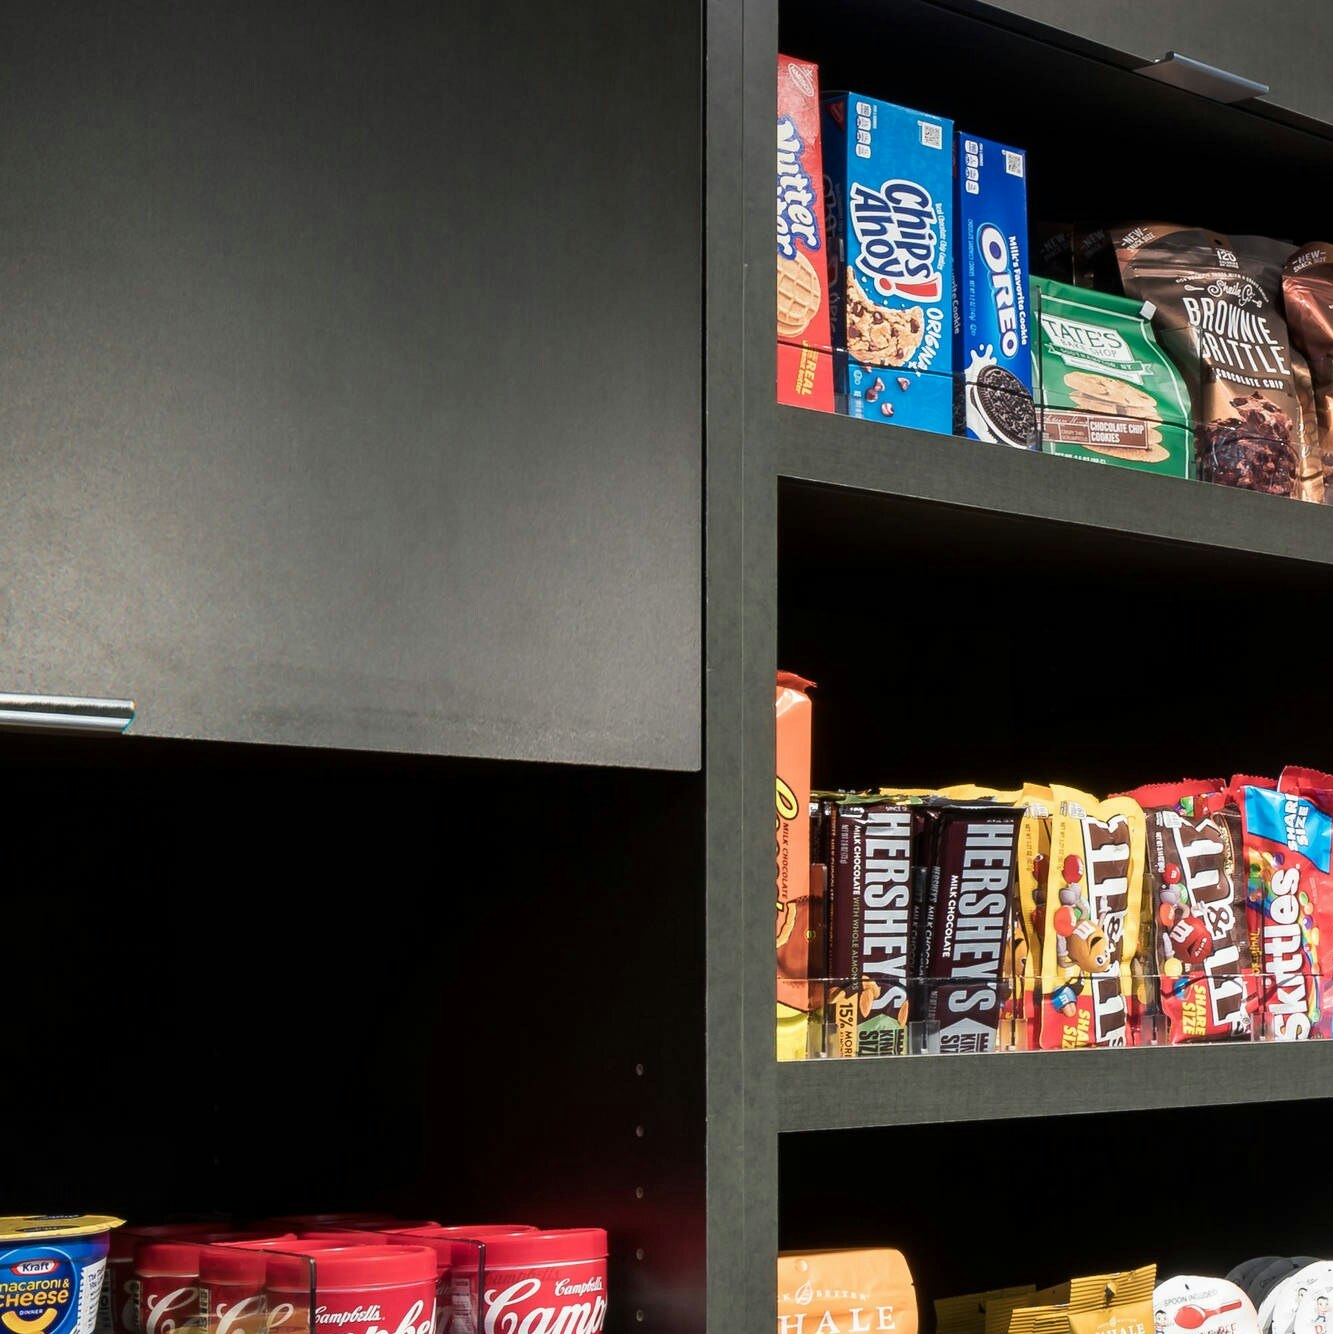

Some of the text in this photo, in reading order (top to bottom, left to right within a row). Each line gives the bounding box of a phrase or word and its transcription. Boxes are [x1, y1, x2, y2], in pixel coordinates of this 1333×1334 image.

[1217, 250, 1237, 262] 120
[980, 226, 1018, 357] OREO
[1009, 235, 1028, 345] Milk's Favorite Cookie
[1042, 319, 1123, 349] TATE'S
[1183, 297, 1278, 345] BROWNIE
[1193, 328, 1291, 375] BRITTLE
[1262, 378, 1285, 390] CHIP
[1090, 421, 1144, 434] CHOCOLATE CHIP
[1090, 432, 1121, 443] COOKIES
[853, 825, 861, 846] MILK
[1297, 804, 1310, 847] SIZE
[782, 842, 790, 900] CHOCOLATE
[853, 846, 861, 895] CHOCOLATE
[852, 915, 861, 942] WHOLE
[863, 813, 911, 1010] HERSHEY'S
[942, 875, 958, 957] MILK CHOCOLATE
[948, 824, 1014, 1012] HERSHEY'S
[1181, 1001, 1196, 1034] SIZE
[1193, 985, 1208, 1035] SHARE
[21, 1261, 50, 1273] Kraft
[63, 1279, 70, 1288] &
[314, 1305, 383, 1325] Campbell's
